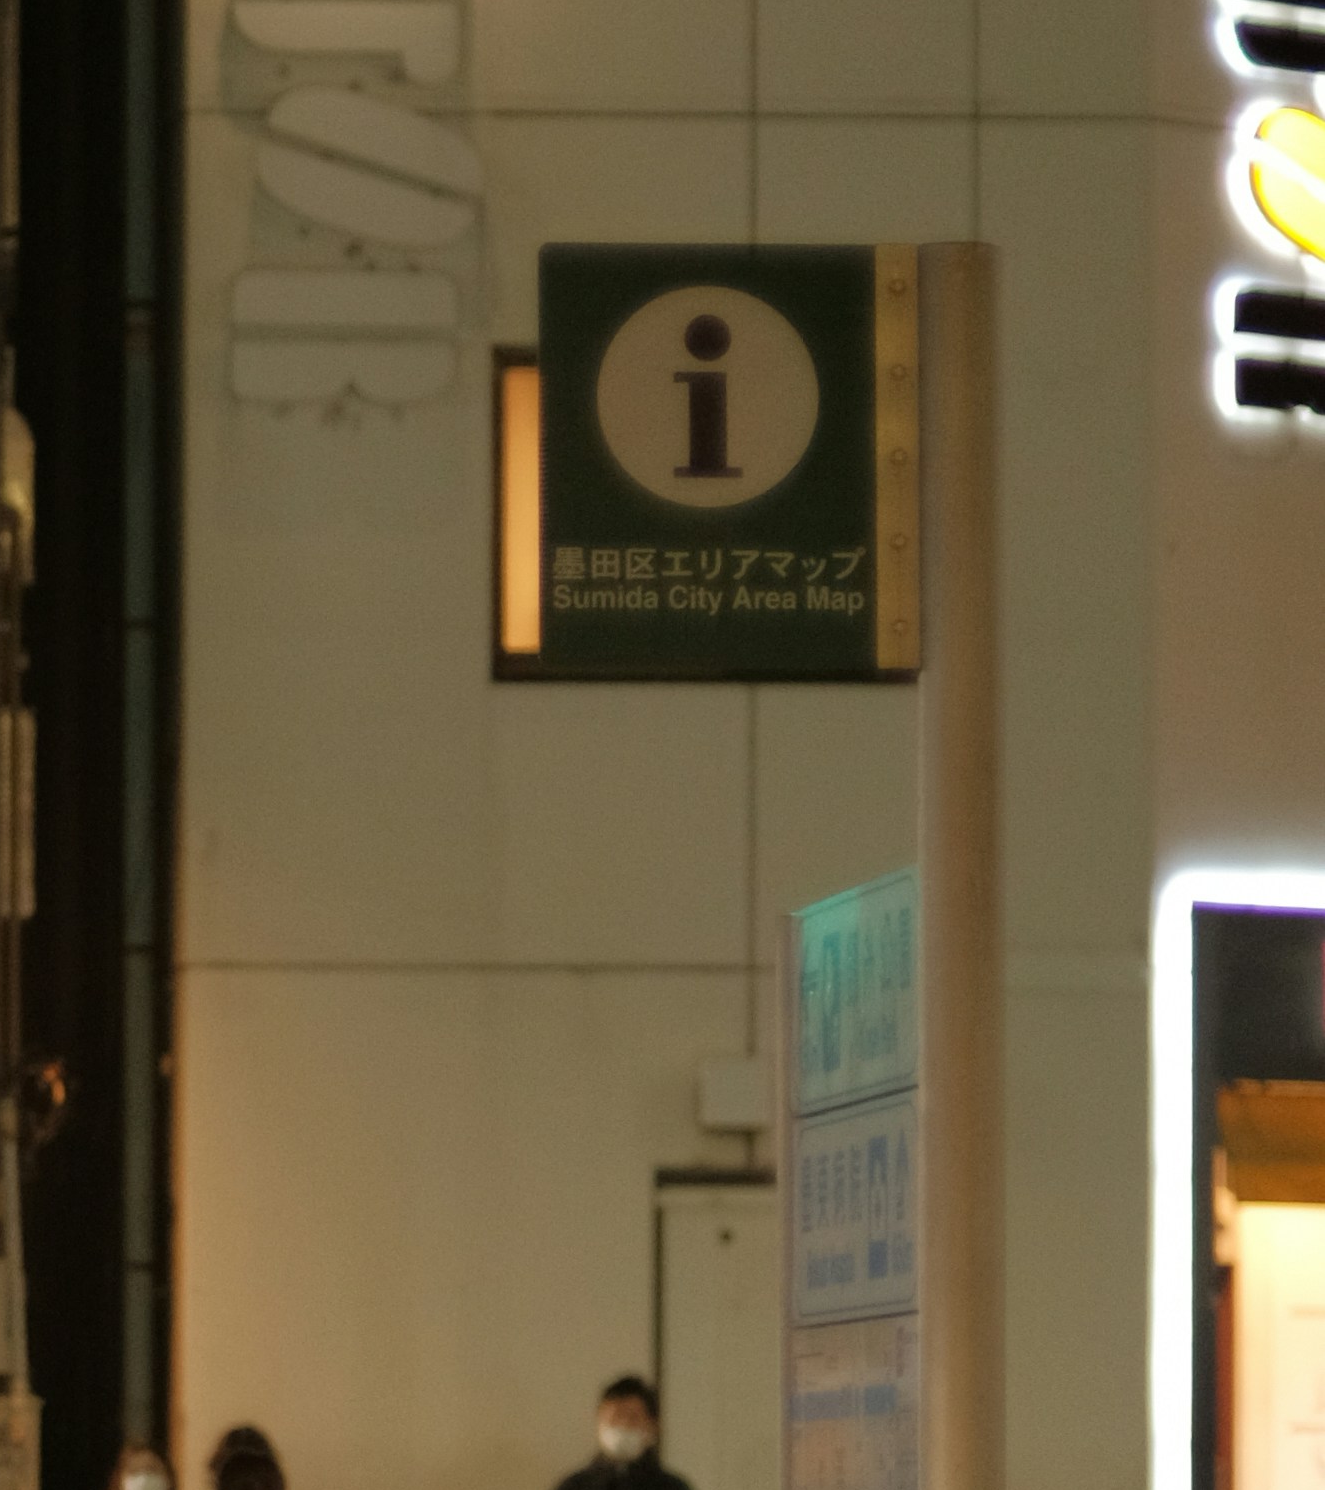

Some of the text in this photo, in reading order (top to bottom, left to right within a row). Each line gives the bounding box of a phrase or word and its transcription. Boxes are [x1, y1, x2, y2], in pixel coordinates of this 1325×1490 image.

[553, 546, 867, 581] 墨田区エリアマップ
[553, 584, 866, 617] Sumida City Area Map
